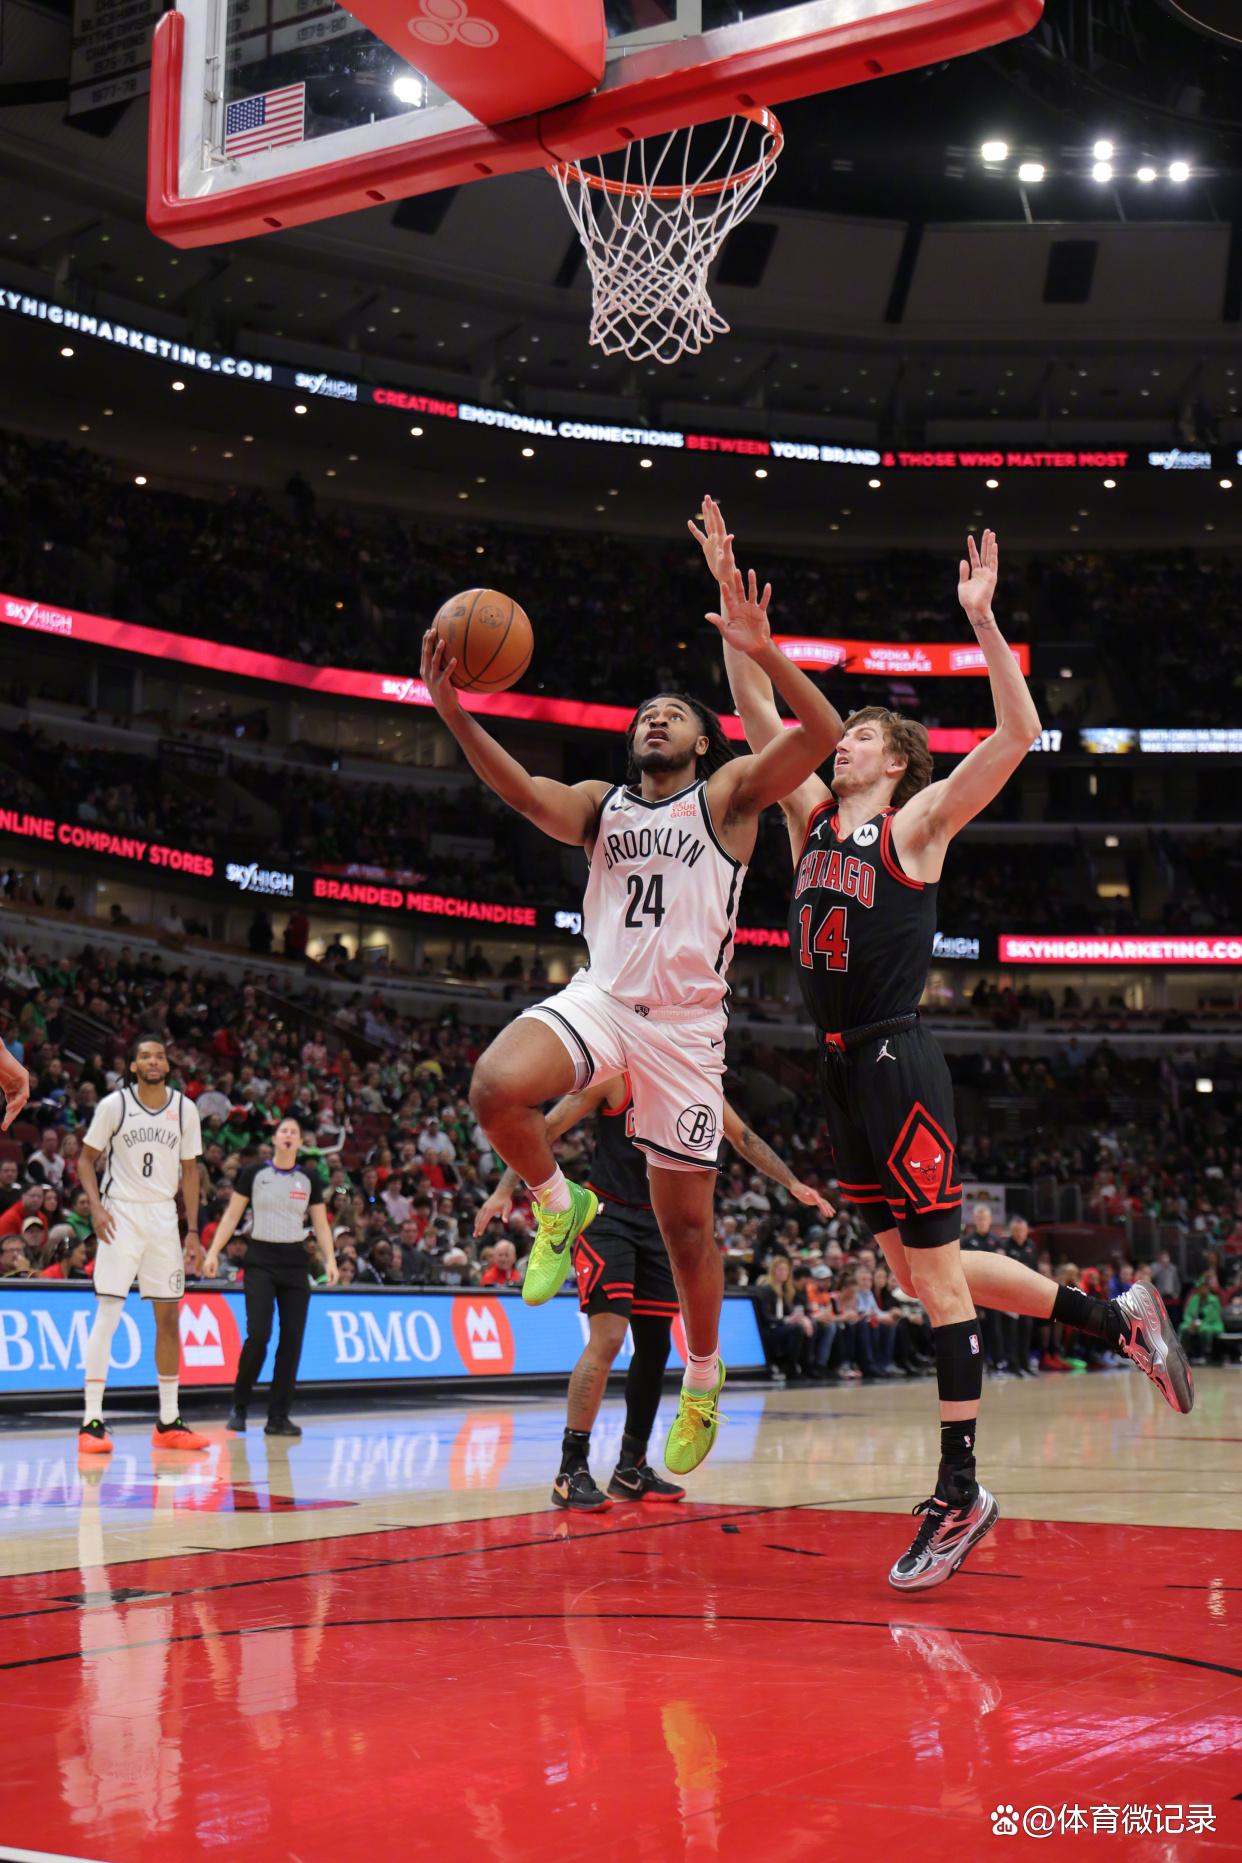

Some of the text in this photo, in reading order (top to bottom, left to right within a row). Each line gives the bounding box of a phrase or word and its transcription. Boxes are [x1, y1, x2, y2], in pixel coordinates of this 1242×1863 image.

[372, 387, 458, 418] CREATING
[458, 404, 558, 436] EMOTIONAL
[558, 421, 684, 448] CONNECTIONS
[685, 434, 770, 456] BETWEEN
[770, 441, 820, 461] YOUR
[820, 445, 880, 466] BRAND
[882, 452, 896, 467] &
[897, 452, 957, 467] THOSE
[958, 452, 1004, 467] WHO
[1006, 453, 1076, 467] MATTER
[1078, 453, 1128, 467] MOST
[863, 659, 932, 672] THE PEOPLE
[58, 823, 146, 861] COMPANY
[149, 844, 214, 877] STORES
[603, 828, 705, 870] BROOKLYN
[226, 862, 294, 892] SKYHIGH
[313, 878, 537, 926] BRANDED MERCHANDISE
[625, 874, 665, 928] 24
[795, 849, 876, 908] CHIAGO
[800, 903, 849, 972] 14
[123, 1127, 179, 1150] BROOKLYN
[142, 1152, 153, 1177] 8
[0, 1309, 142, 1371] BMO
[326, 1310, 442, 1363] BMO
